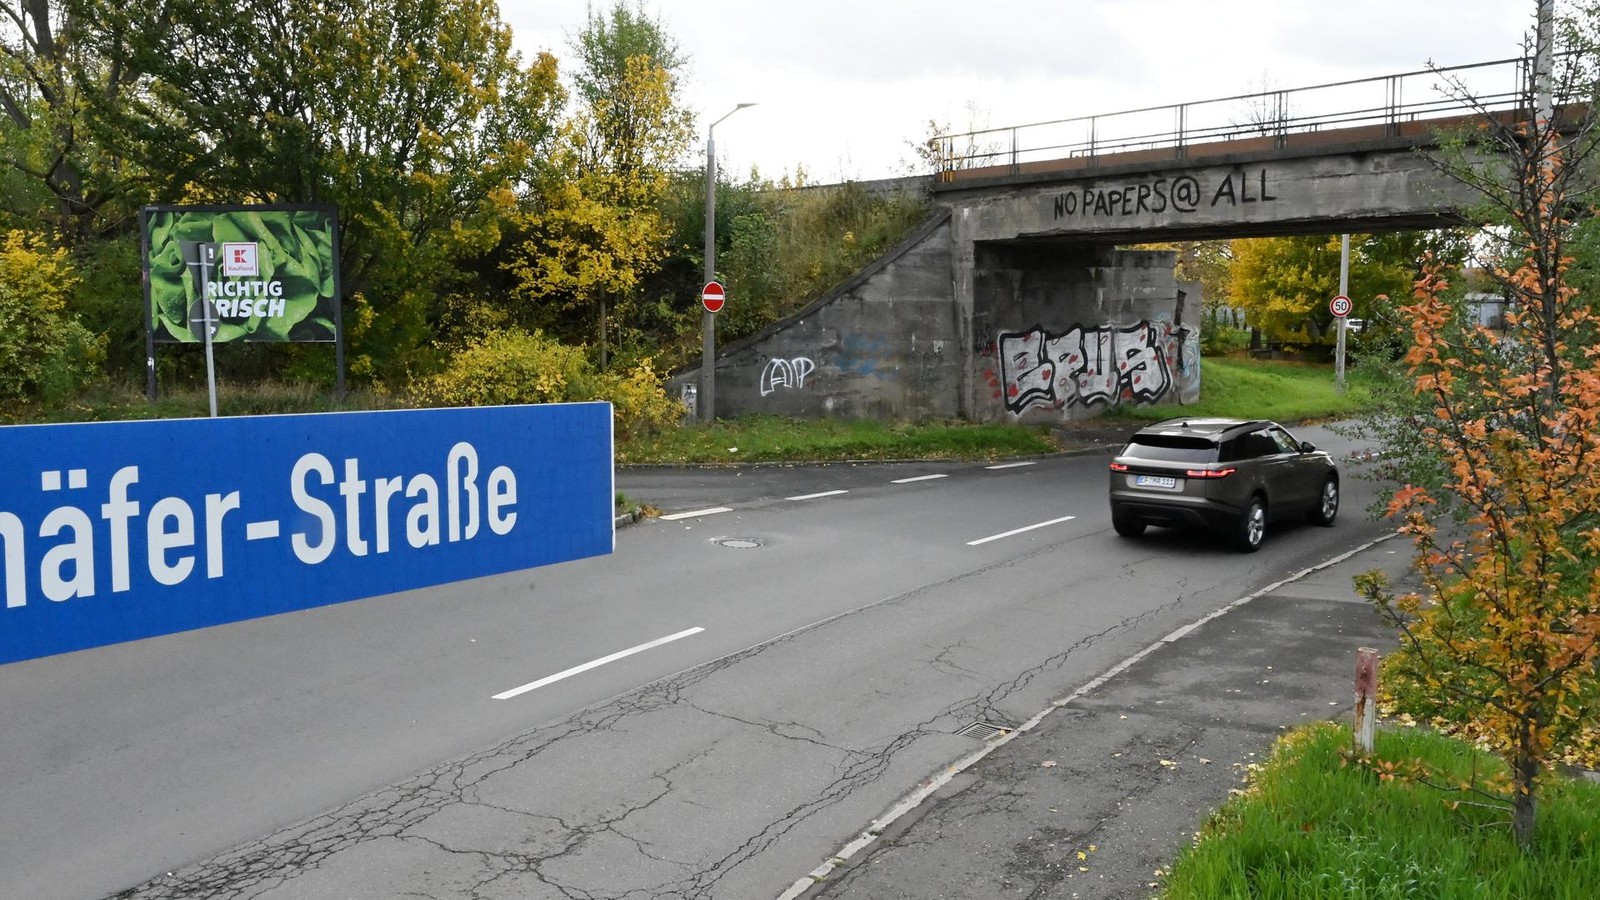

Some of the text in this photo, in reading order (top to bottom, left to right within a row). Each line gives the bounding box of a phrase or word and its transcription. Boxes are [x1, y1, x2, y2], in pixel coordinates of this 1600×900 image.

[1054, 191, 1077, 220] NO
[1211, 169, 1277, 207] ALL
[207, 281, 283, 297] RICHTIG
[209, 298, 286, 318] RISCH
[1335, 301, 1347, 311] 50
